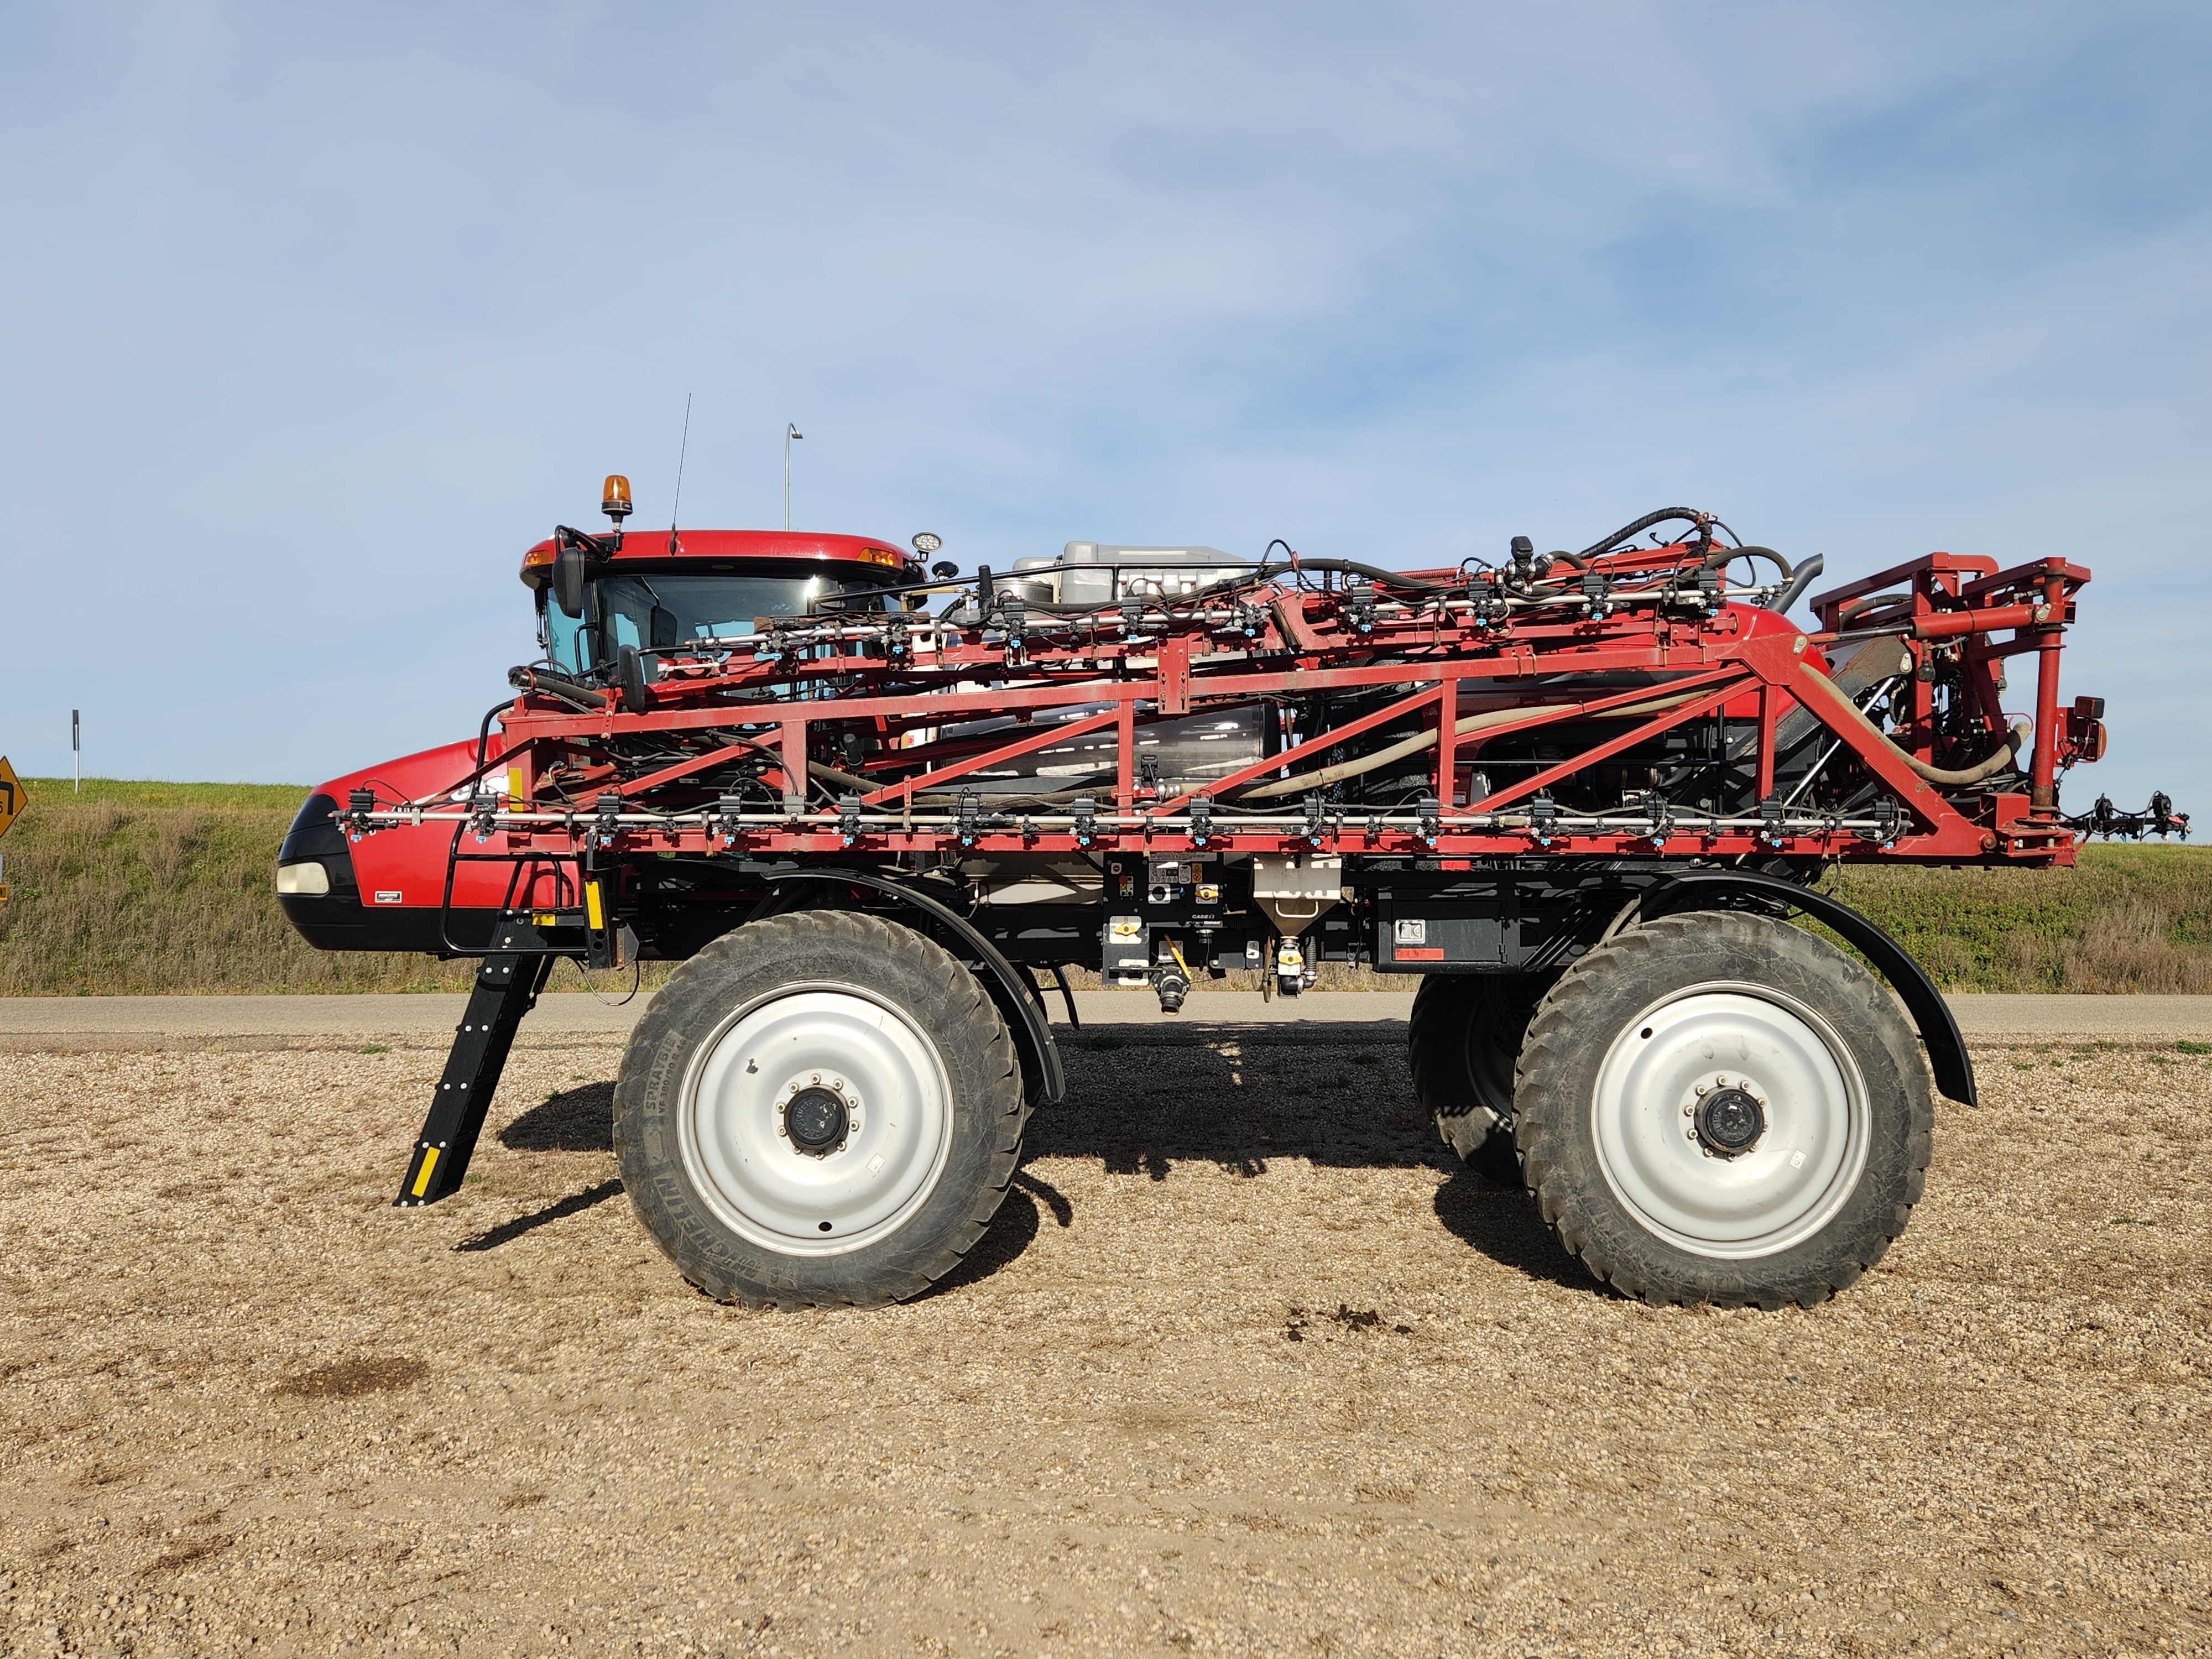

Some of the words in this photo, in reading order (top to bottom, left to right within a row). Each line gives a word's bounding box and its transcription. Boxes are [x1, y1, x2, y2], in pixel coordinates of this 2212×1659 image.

[646, 1036, 676, 1110] SPRAYBIB
[660, 1062, 676, 1098] 380/90
[658, 1100, 666, 1114] VF
[655, 1178, 764, 1279] MICHELIN
